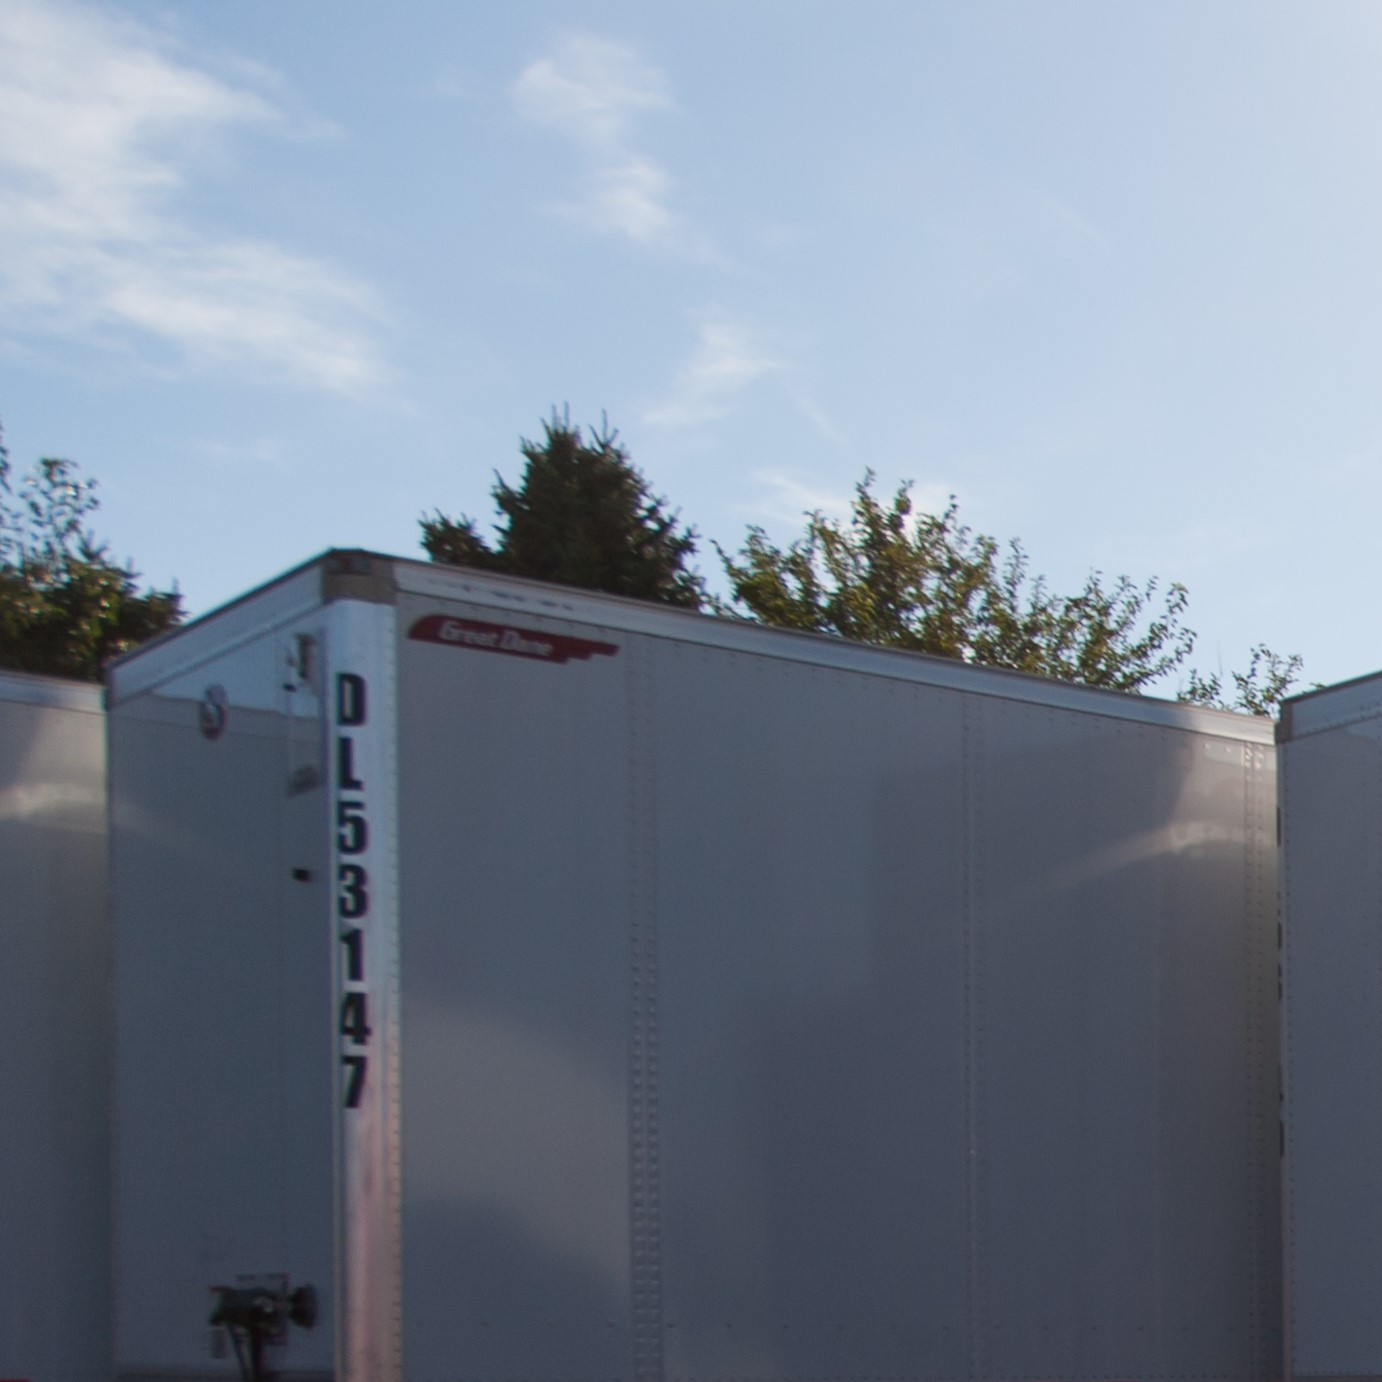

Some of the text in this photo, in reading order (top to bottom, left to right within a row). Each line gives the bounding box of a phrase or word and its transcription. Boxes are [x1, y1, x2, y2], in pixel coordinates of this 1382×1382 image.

[440, 620, 555, 657] Great Dane
[337, 672, 371, 1109] DL53147
